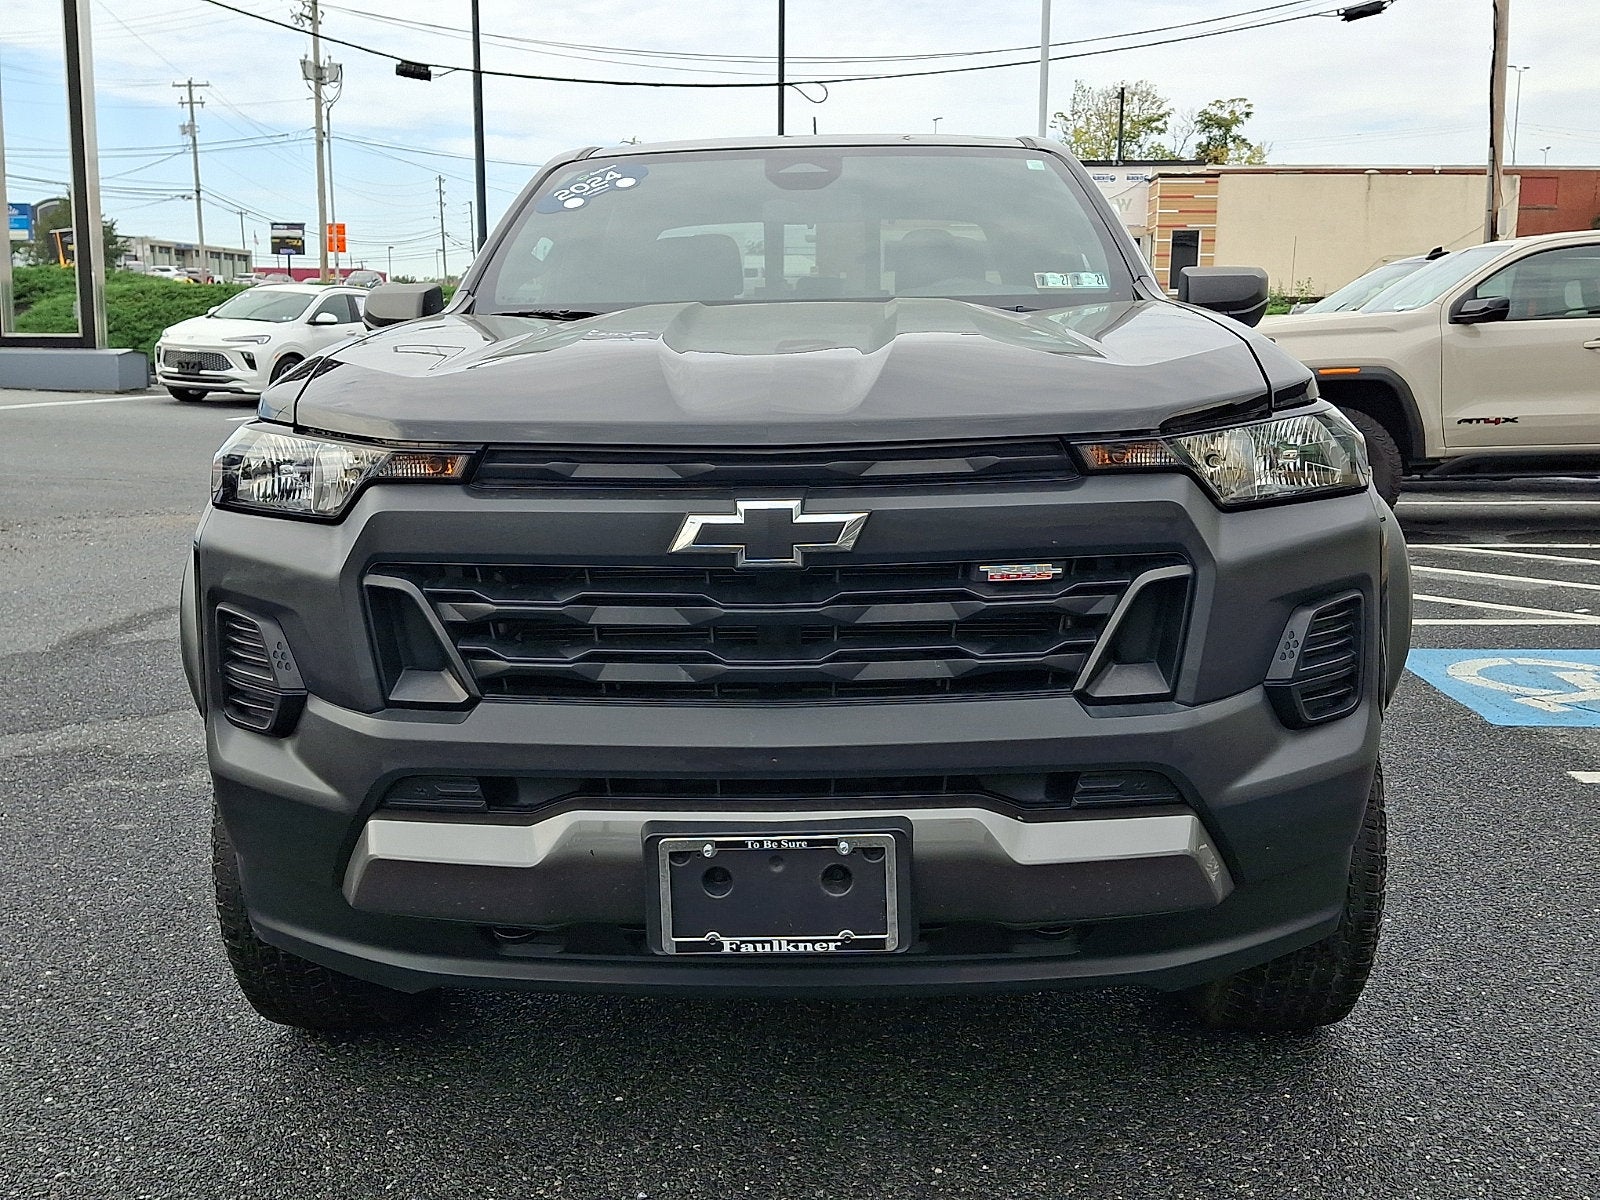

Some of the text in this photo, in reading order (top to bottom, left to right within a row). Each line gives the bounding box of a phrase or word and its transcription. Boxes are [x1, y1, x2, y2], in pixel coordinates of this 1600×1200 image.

[553, 171, 622, 201] 2024
[1457, 417, 1519, 425] AT4X
[745, 839, 808, 849] To Be Sure
[721, 939, 842, 953] Faulkner
